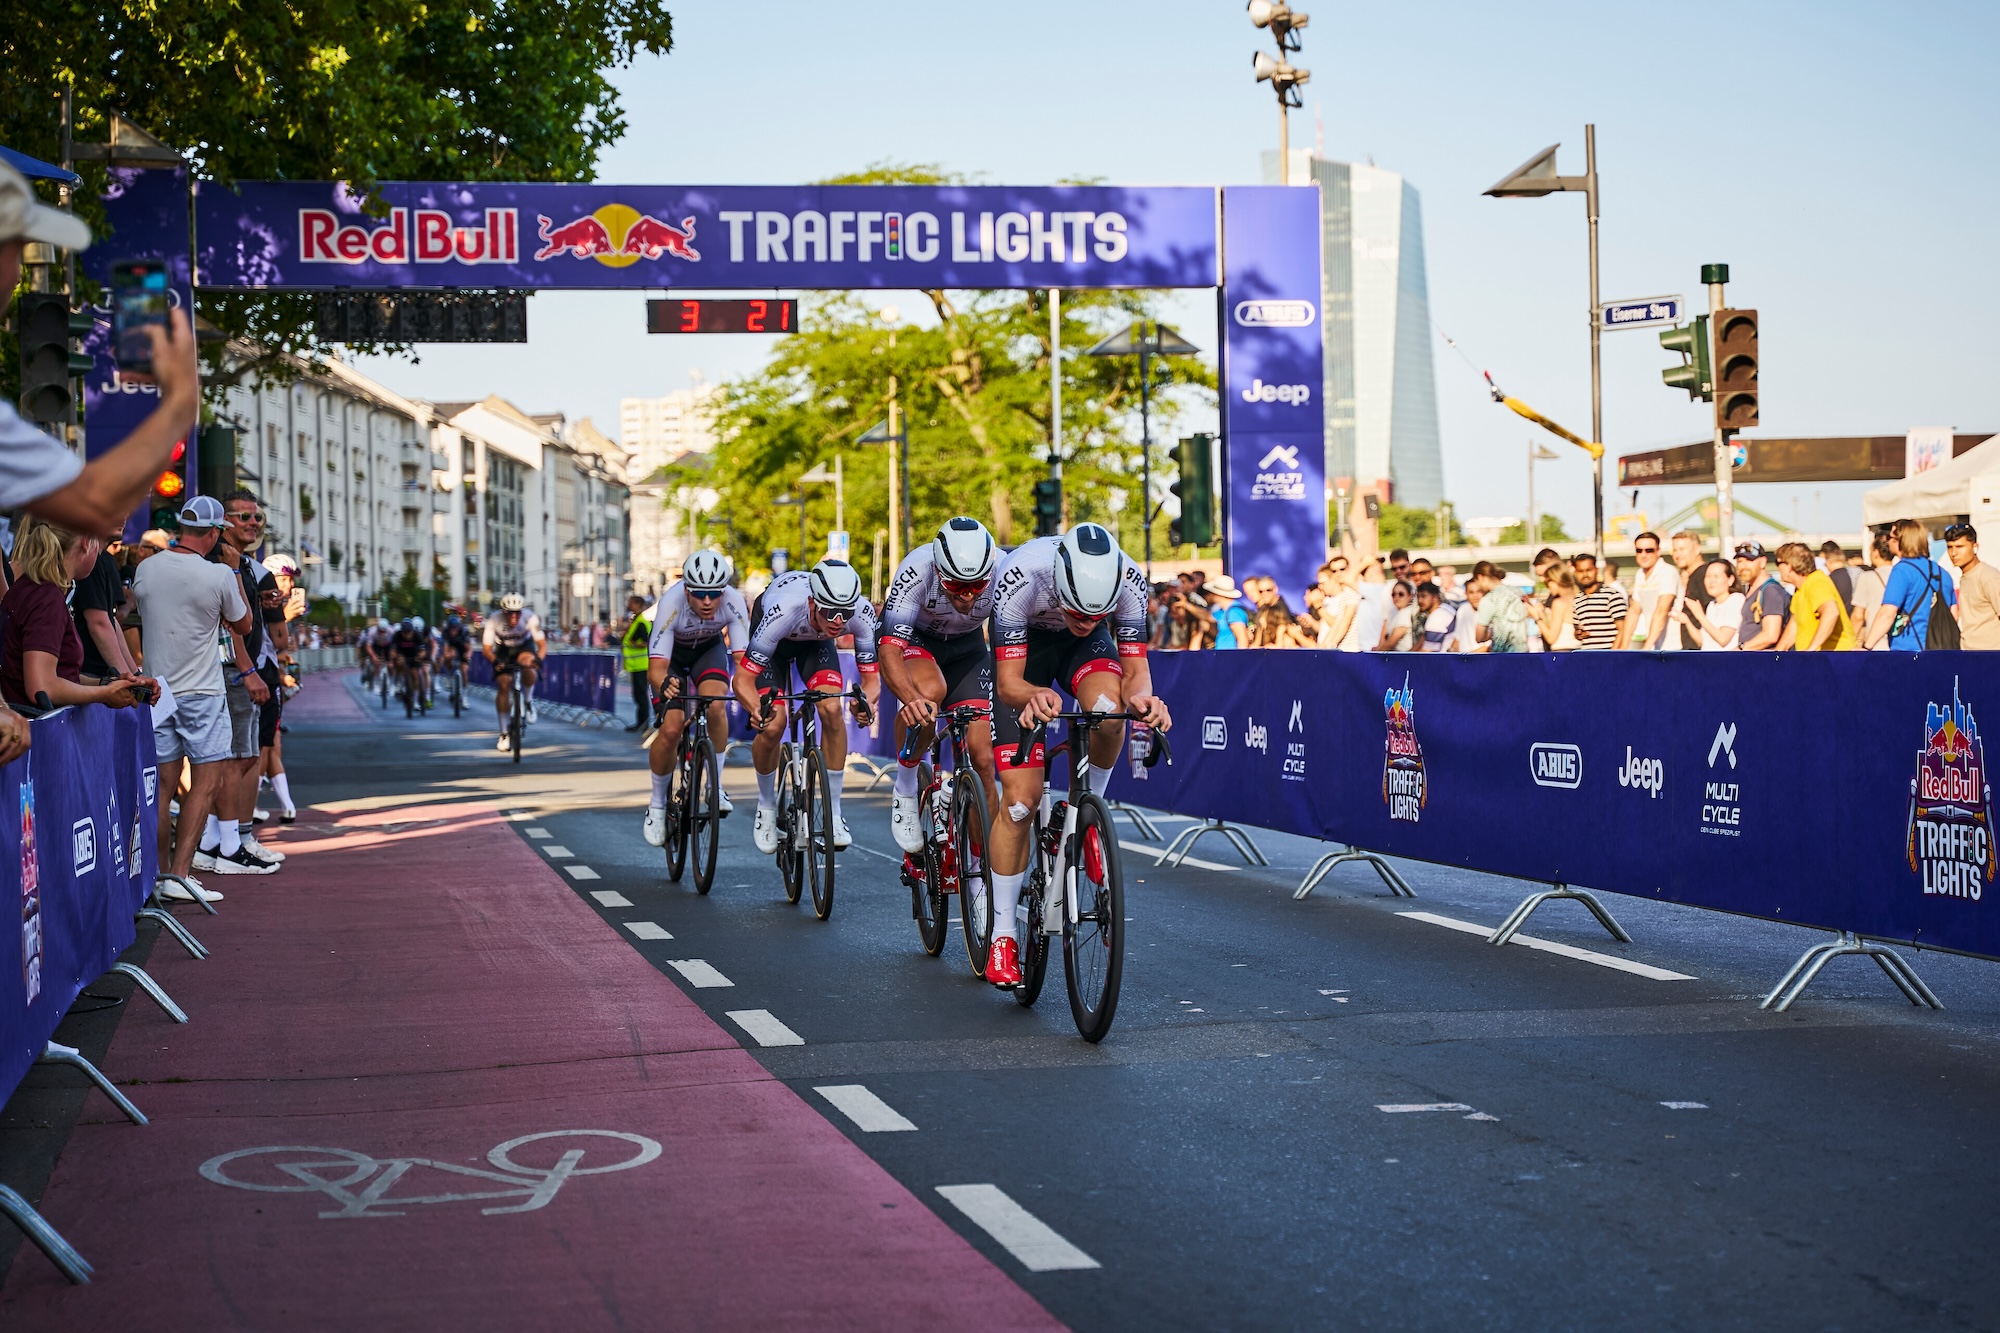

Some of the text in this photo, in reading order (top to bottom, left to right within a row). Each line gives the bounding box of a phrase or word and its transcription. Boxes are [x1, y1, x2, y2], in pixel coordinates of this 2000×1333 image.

[299, 208, 519, 264] Red Bull
[719, 211, 1128, 263] TRAFFIC LIGHTS
[681, 300, 790, 332] 3 21
[1241, 379, 1311, 406] Jeep
[1251, 484, 1305, 495] CYCLE
[1256, 472, 1303, 484] MULTI
[886, 566, 919, 611] BROSCH
[1245, 717, 1267, 755] Jeep
[1283, 759, 1305, 774] CYCLE
[1538, 752, 1576, 779] ABUS
[1618, 745, 1663, 799] Jeep
[1387, 768, 1422, 798] TRAFFIC
[1705, 782, 1738, 801] MULTI
[1922, 765, 1979, 803] Red Bull
[1390, 795, 1419, 823] LIGHTS
[1702, 804, 1740, 825] CYCLE
[1917, 820, 1987, 866] TRAFFIC
[1923, 859, 1982, 901] LIGHTS
